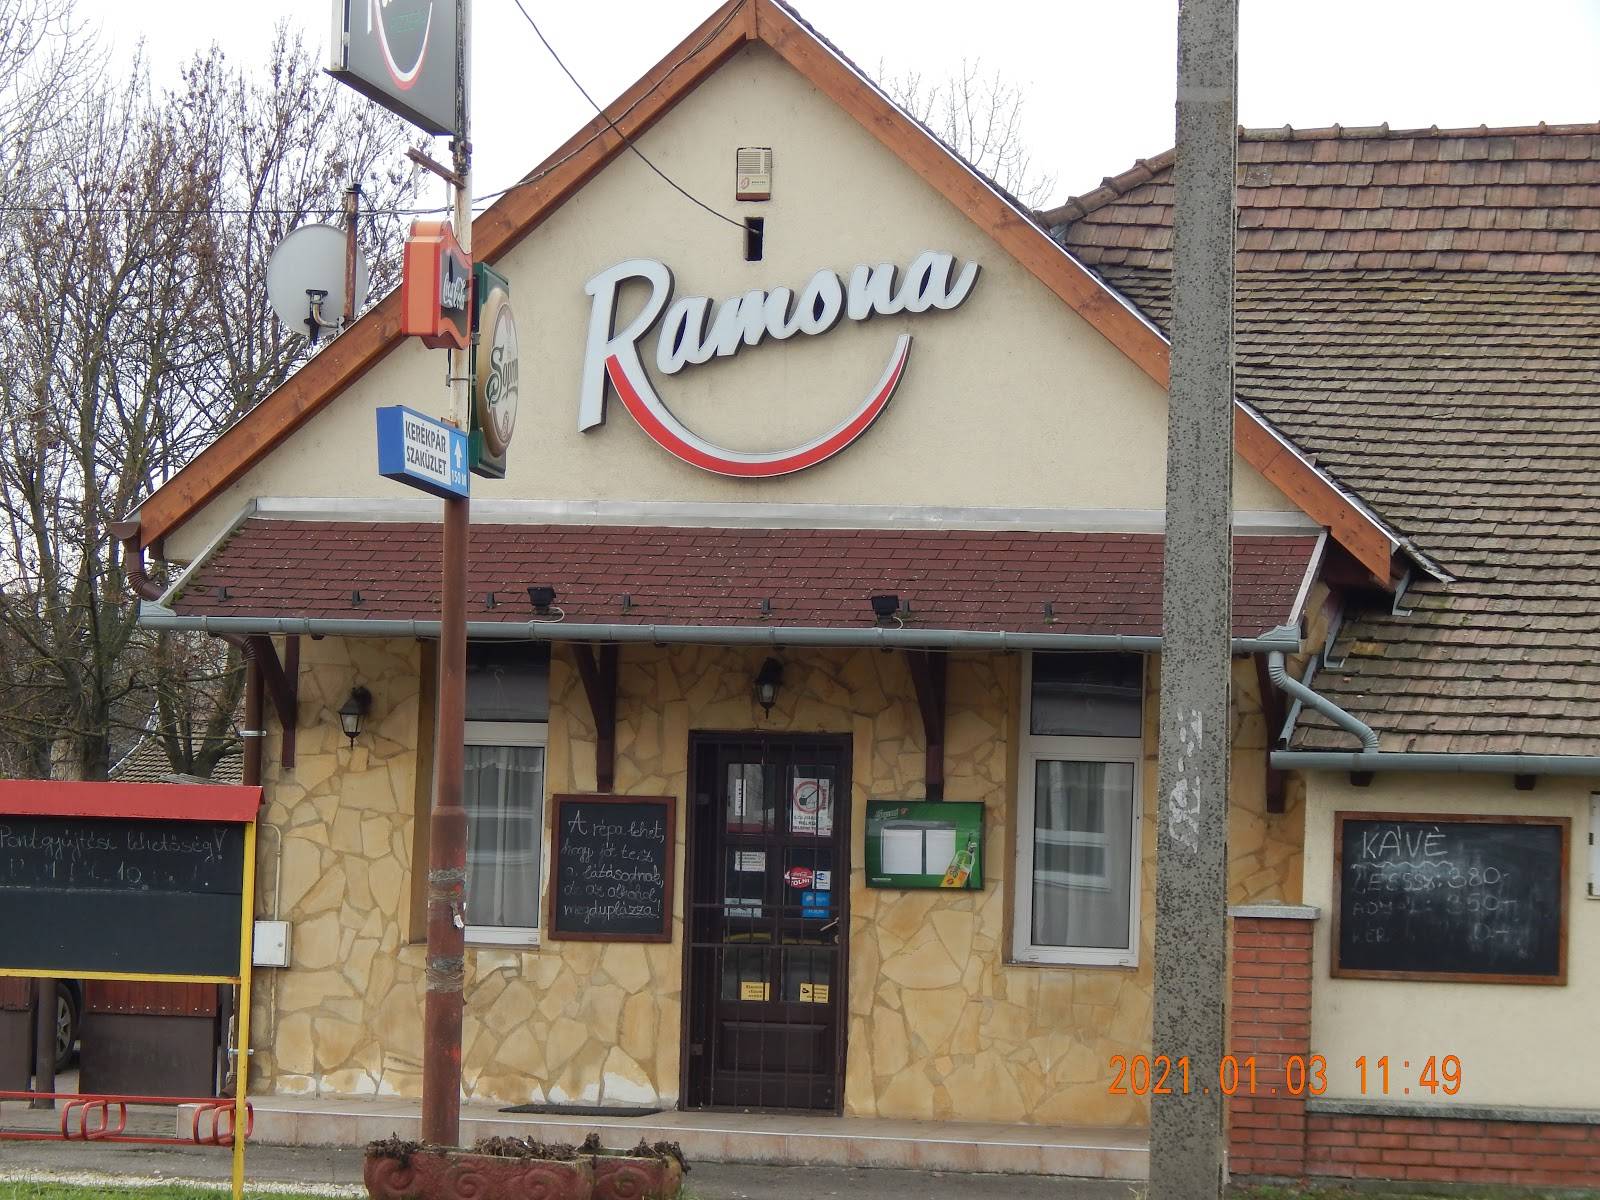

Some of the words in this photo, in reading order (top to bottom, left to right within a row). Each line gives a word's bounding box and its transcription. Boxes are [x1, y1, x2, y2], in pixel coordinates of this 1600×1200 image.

[578, 249, 982, 478] Ramona
[405, 421, 447, 454] KERÉKPÁR
[568, 809, 588, 835] A
